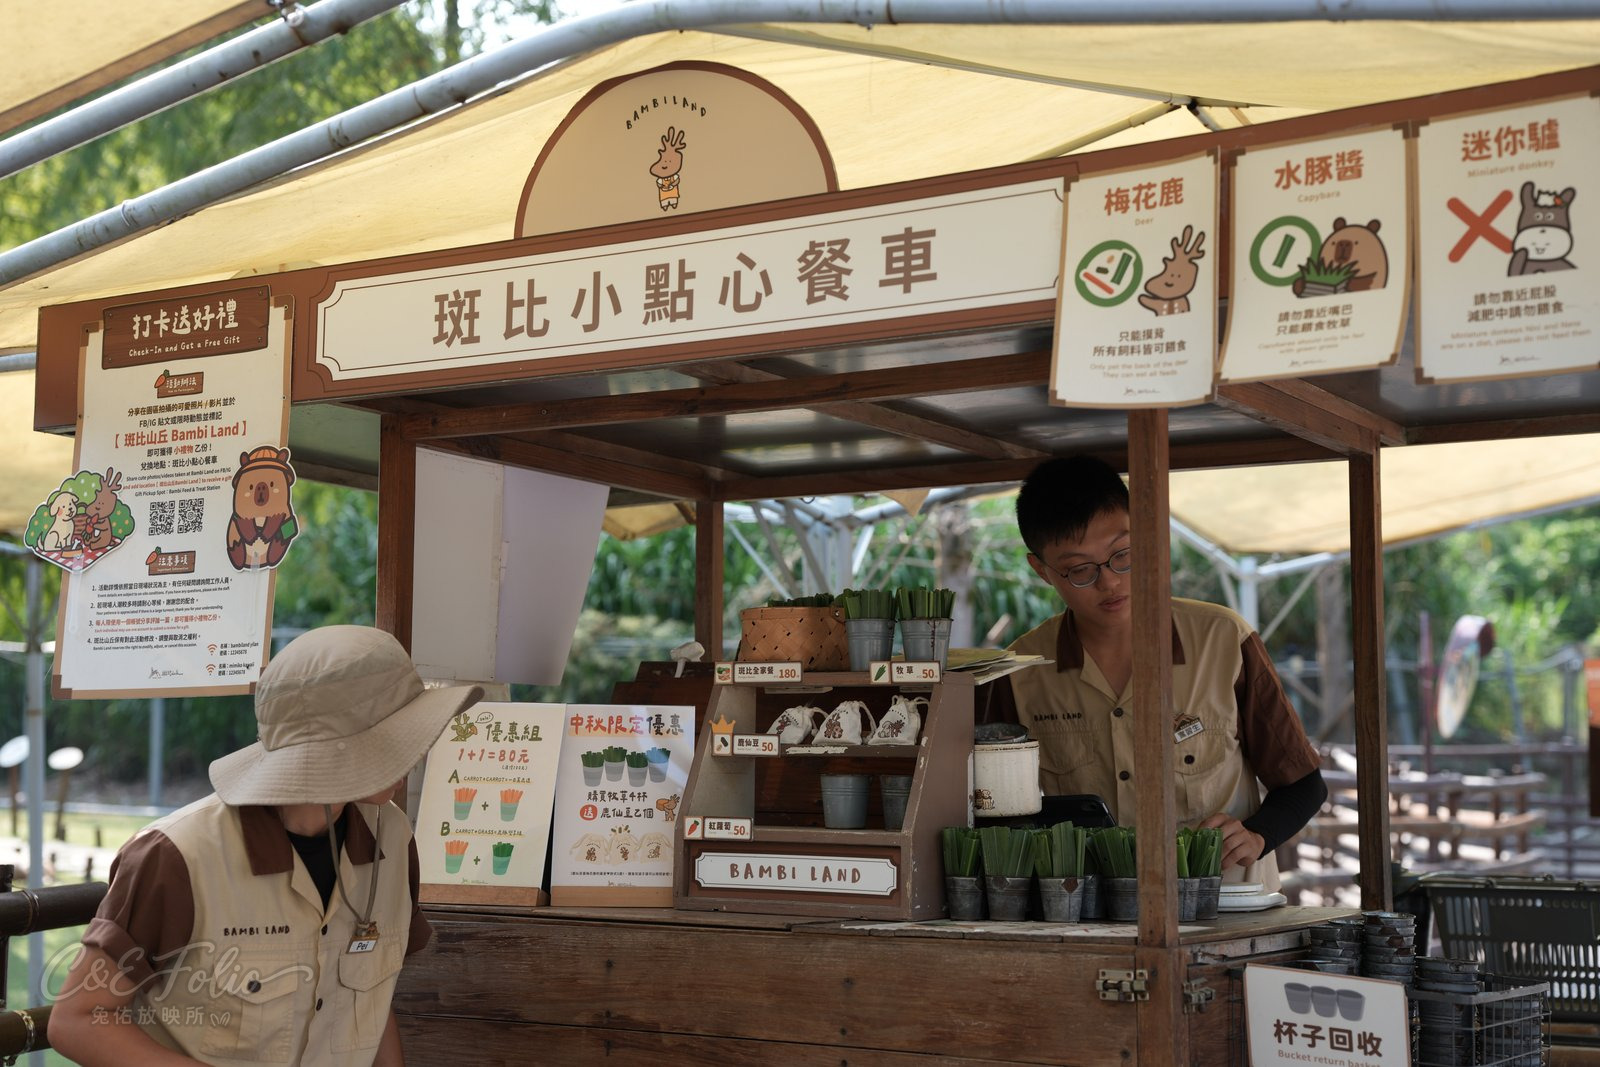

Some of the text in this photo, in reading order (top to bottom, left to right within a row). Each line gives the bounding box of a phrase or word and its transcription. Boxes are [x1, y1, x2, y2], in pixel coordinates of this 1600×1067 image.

[1461, 117, 1560, 162] 迷你驢
[1274, 149, 1364, 190] 水豚醬
[1467, 159, 1555, 178] Miniature donkey
[1104, 177, 1184, 216] 梅花鹿
[1297, 190, 1340, 203] Capybara
[1134, 218, 1154, 226] Deer
[432, 225, 939, 348] 斑比小點心餐車
[1473, 284, 1557, 306] 請勿靠近屁股
[132, 298, 239, 340] 打卡送好禮
[1277, 303, 1353, 322] 請勿靠近嘴巴
[1467, 300, 1564, 323] 減肥中請勿餵食
[1275, 316, 1351, 336] 只能餵食牧草
[1118, 327, 1165, 342] 只能摸背
[128, 346, 162, 357] Check-In
[165, 343, 178, 352] and
[180, 341, 194, 350] Get
[204, 338, 220, 348] Free
[224, 336, 240, 345] Gift
[1092, 340, 1187, 357] 所有飼料皆可餵食
[166, 376, 197, 389] 活動辦法
[1102, 372, 1118, 380] They
[139, 411, 223, 428] FB/IG 貼文或限時動態並標記
[124, 428, 168, 448] 斑比山丘
[171, 425, 208, 442] Bambi
[210, 422, 239, 438] Land
[147, 446, 173, 458] 即可獲得
[174, 445, 194, 455] 小禮物
[147, 473, 174, 481] photos/videos
[158, 554, 188, 566] 注意事項
[738, 666, 774, 675] 斑比全家餐
[778, 668, 796, 679] 180
[896, 666, 934, 679] 牧草 50
[570, 713, 684, 736] 中秋限定優惠
[1033, 711, 1082, 722] BAMBI LAND
[486, 721, 542, 743] 優惠組
[738, 738, 759, 747] 鹿仙豆
[762, 742, 774, 752] 50
[458, 748, 530, 764] 1+1=80元
[448, 769, 460, 784] A
[587, 790, 648, 803] 購買牧草4杯
[584, 806, 654, 819] 送 鹿仙豆乙個
[440, 821, 451, 836] B
[708, 821, 746, 835] 紅蘿蔔 50
[729, 863, 862, 884] BAMBI LAND
[223, 925, 291, 937] BAMBI LAND
[356, 941, 369, 950] Pei
[1273, 1018, 1383, 1058] 杯子回收
[1277, 1049, 1312, 1062] Bucket
[1314, 1055, 1345, 1067] return
